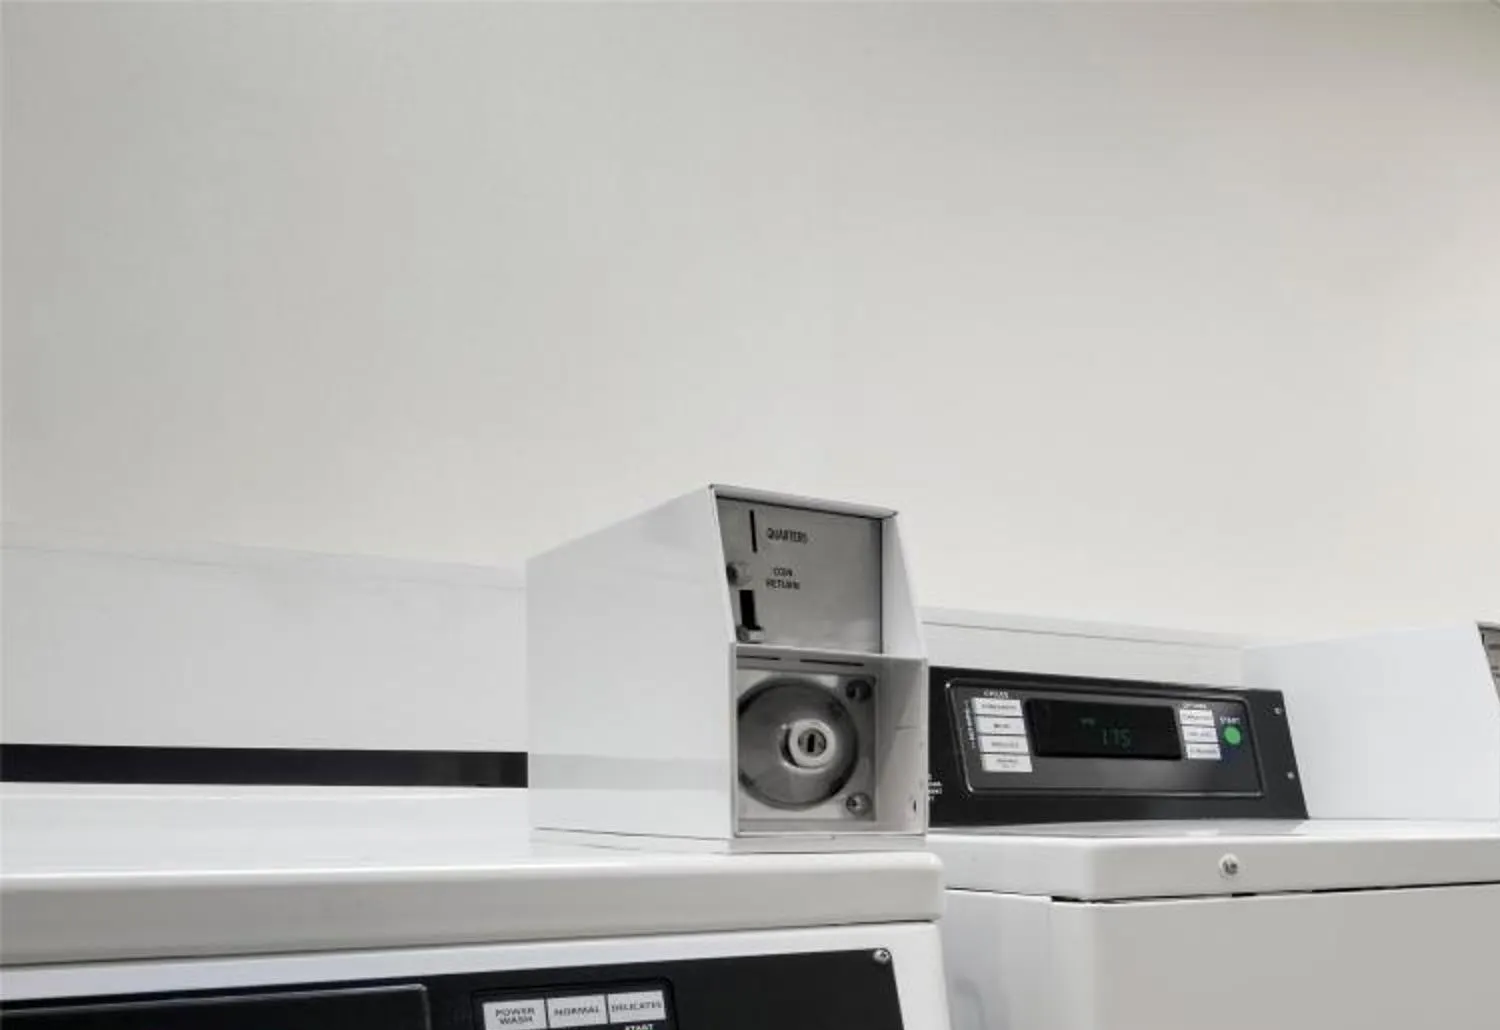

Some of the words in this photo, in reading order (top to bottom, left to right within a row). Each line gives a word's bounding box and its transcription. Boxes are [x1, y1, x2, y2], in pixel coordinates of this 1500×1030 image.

[767, 527, 808, 545] QUARTERS
[773, 567, 793, 577] COIN
[766, 579, 800, 590] RETURN
[495, 1007, 536, 1017] POWER
[553, 1006, 600, 1017] NORMAL
